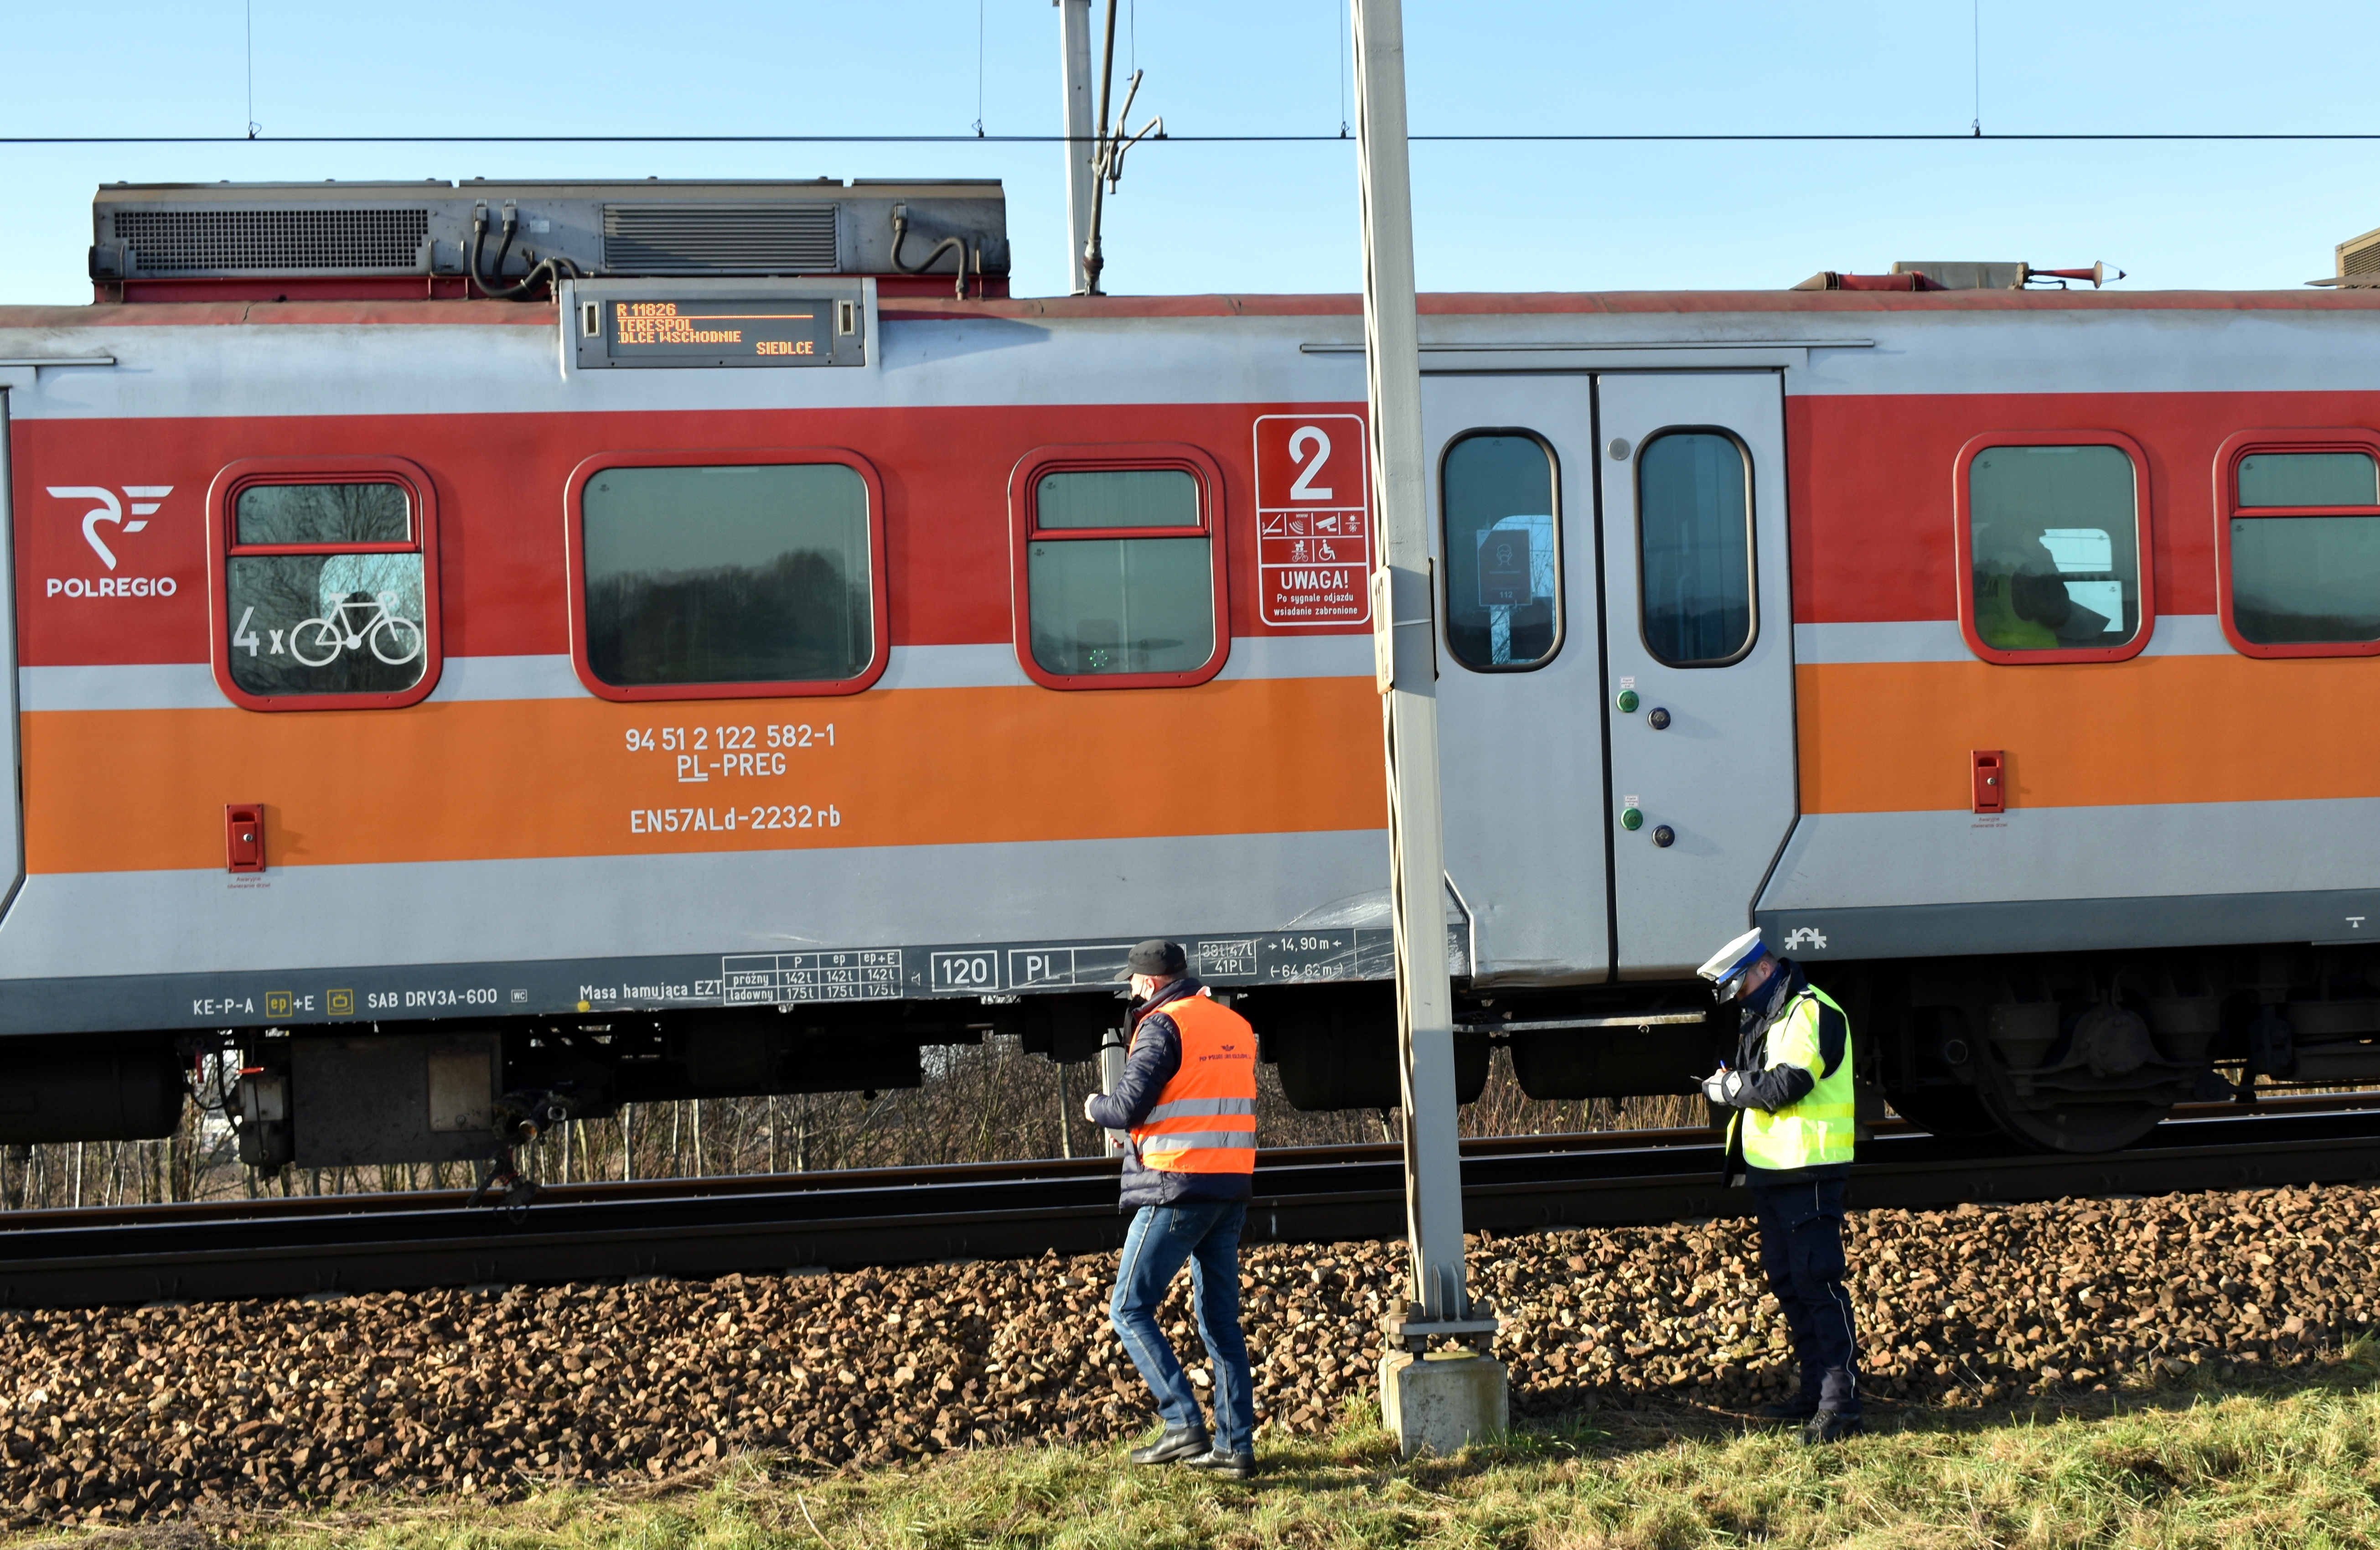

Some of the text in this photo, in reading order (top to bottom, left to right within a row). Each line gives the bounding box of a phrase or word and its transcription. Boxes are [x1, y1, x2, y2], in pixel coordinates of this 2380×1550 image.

[617, 304, 676, 316] R 11826
[617, 319, 694, 332] TERESPOL
[618, 331, 741, 343] DLCE WSCHODNIE
[756, 342, 813, 355] SIEDLCE
[1288, 426, 1333, 500] 2
[47, 577, 177, 597] POLREGIO
[1281, 570, 1349, 590] UWAGA!
[1277, 592, 1354, 604] Po sygnale odjazdu
[1273, 606, 1358, 616] wsiadanie zabronione
[626, 723, 835, 752] 94 51 2 122 582-1
[678, 752, 786, 779] PL-PREG
[795, 956, 802, 968] P
[833, 954, 846, 966] ep
[733, 972, 769, 987] próżny
[942, 957, 987, 985] 120
[368, 988, 497, 1008] SAB DRV3A-600
[579, 980, 723, 1001] Masa hamująca EZT
[193, 997, 254, 1016] KE-P-A
[271, 998, 287, 1013] ep
